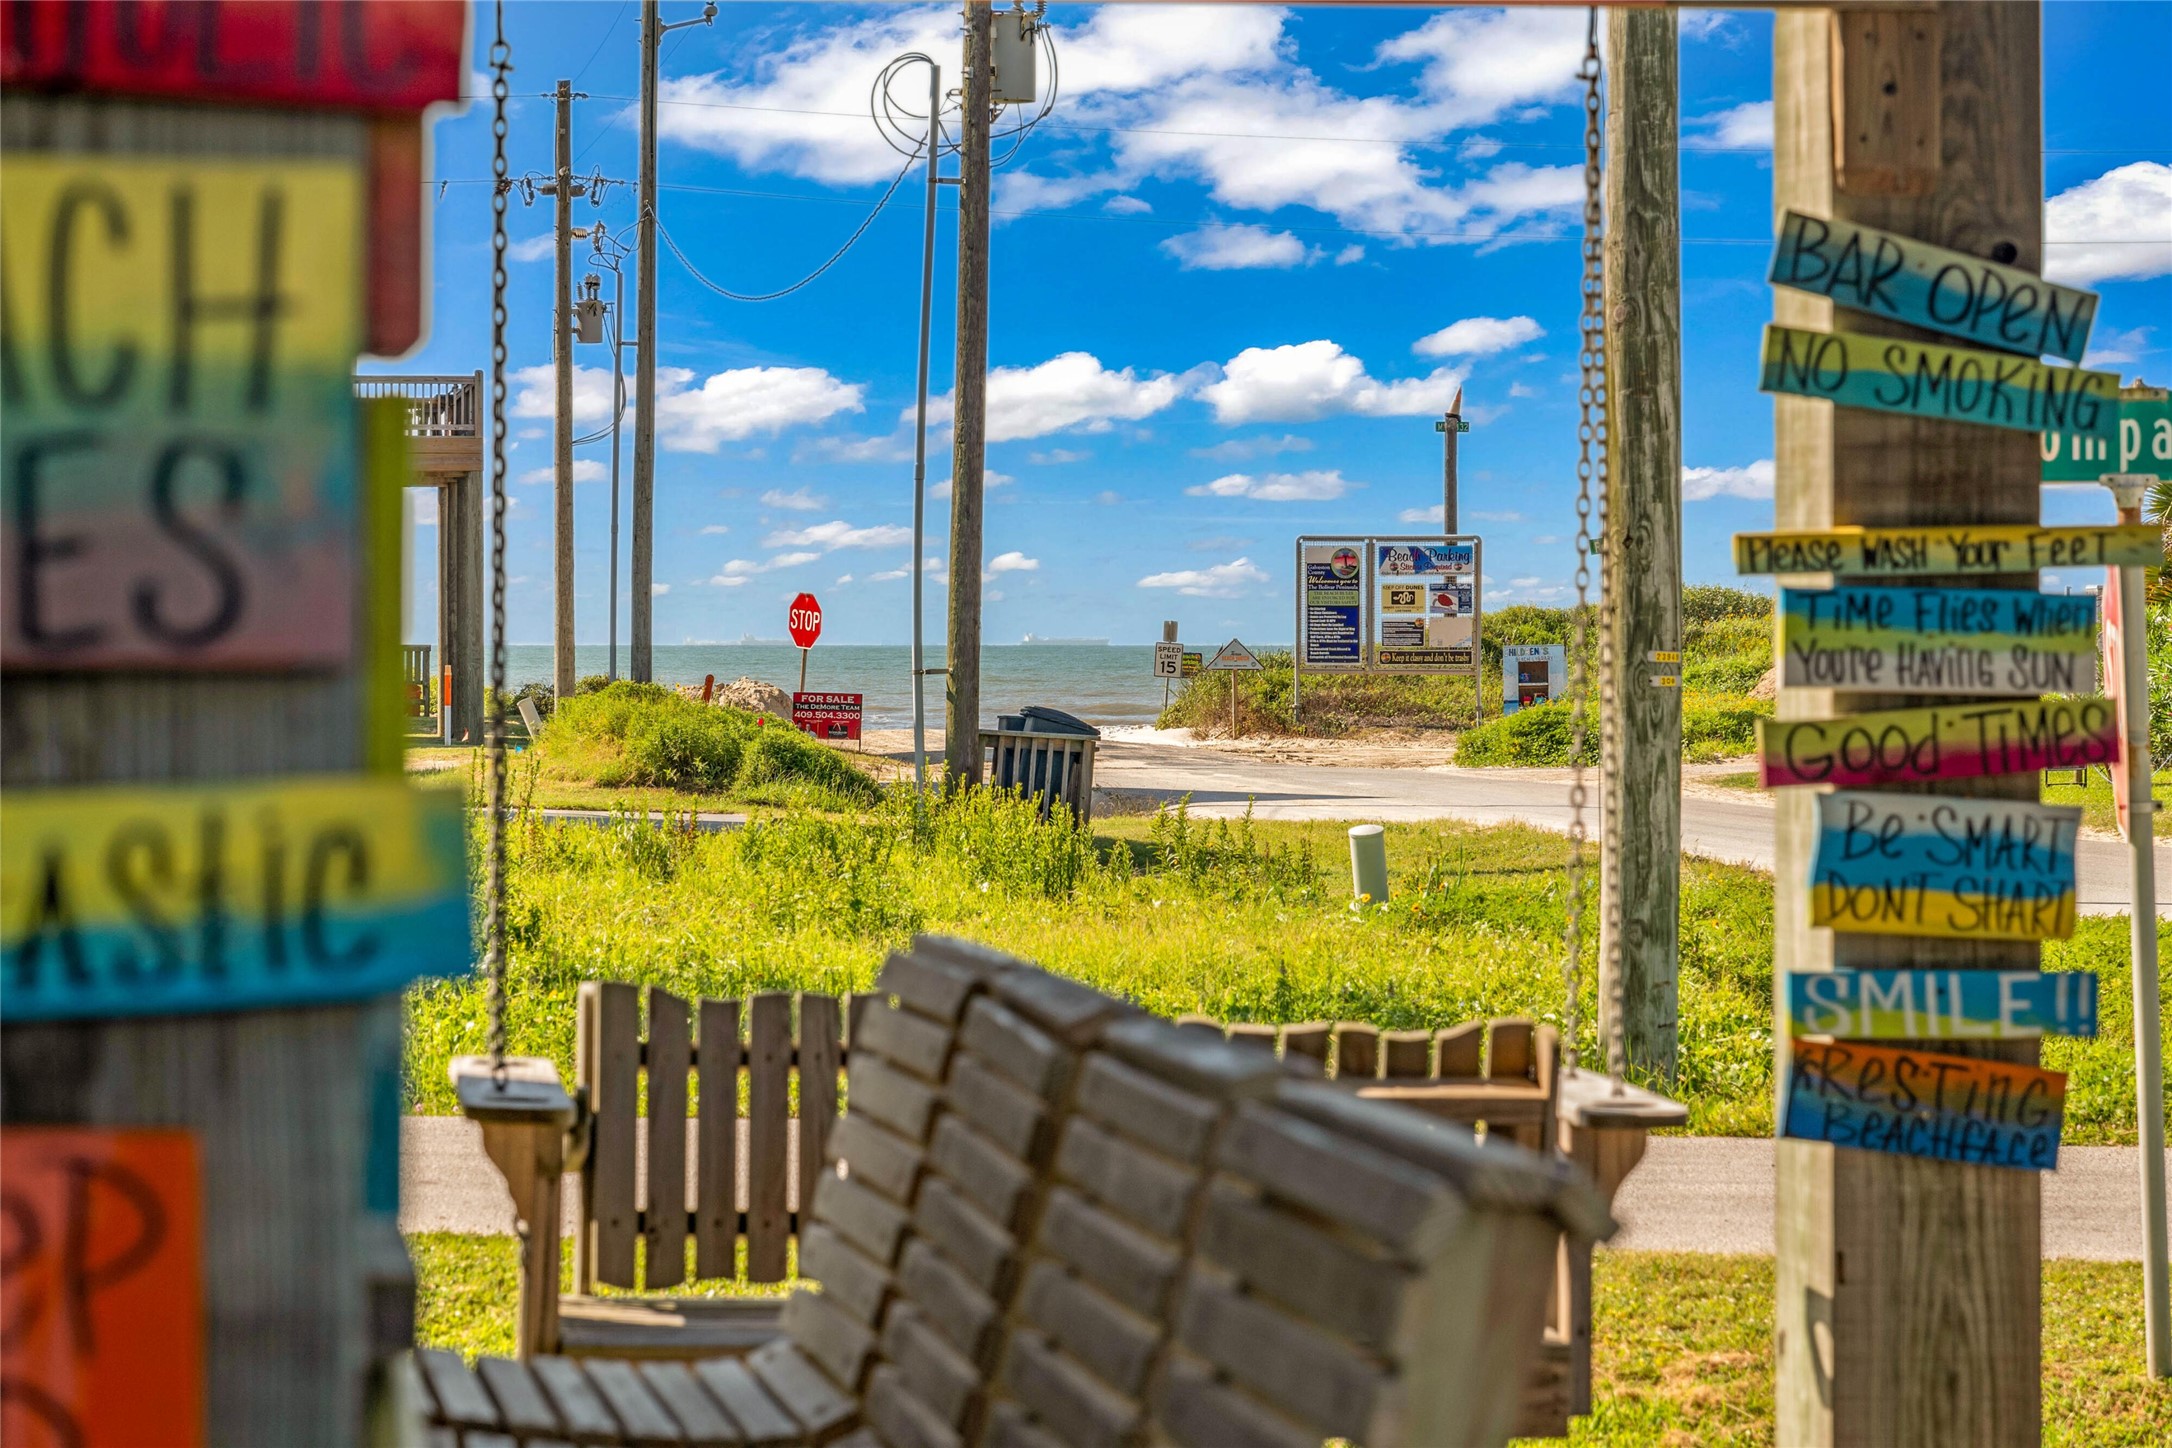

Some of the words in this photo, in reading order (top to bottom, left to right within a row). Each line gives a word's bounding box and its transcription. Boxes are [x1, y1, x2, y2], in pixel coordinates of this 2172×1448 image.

[1790, 213, 1904, 312] BAR
[0, 178, 300, 415] CH
[1775, 335, 1849, 393] NO
[14, 430, 246, 650] ES
[1388, 547, 1420, 562] Beach
[1424, 547, 1470, 565] Parking
[1861, 534, 1929, 571] WASH
[1307, 575, 1339, 584] Welcomes
[790, 608, 821, 632] STOP
[1160, 660, 1176, 674] 15
[1391, 652, 1405, 663] Keep
[1405, 652, 1410, 662] it
[1410, 652, 1424, 663] classy
[1424, 652, 1434, 662] and
[1434, 652, 1448, 662] don't
[1448, 652, 1455, 662] be
[1455, 652, 1470, 663] trashy
[2007, 643, 2078, 690] SUN
[794, 710, 861, 720] 409.504.3300
[801, 695, 824, 703] FOR
[826, 695, 855, 704] SALE
[1839, 799, 1905, 861] Be
[1926, 804, 2079, 874] SMART
[1947, 875, 2072, 935] SHART
[1804, 971, 2092, 1038] SMILE!!
